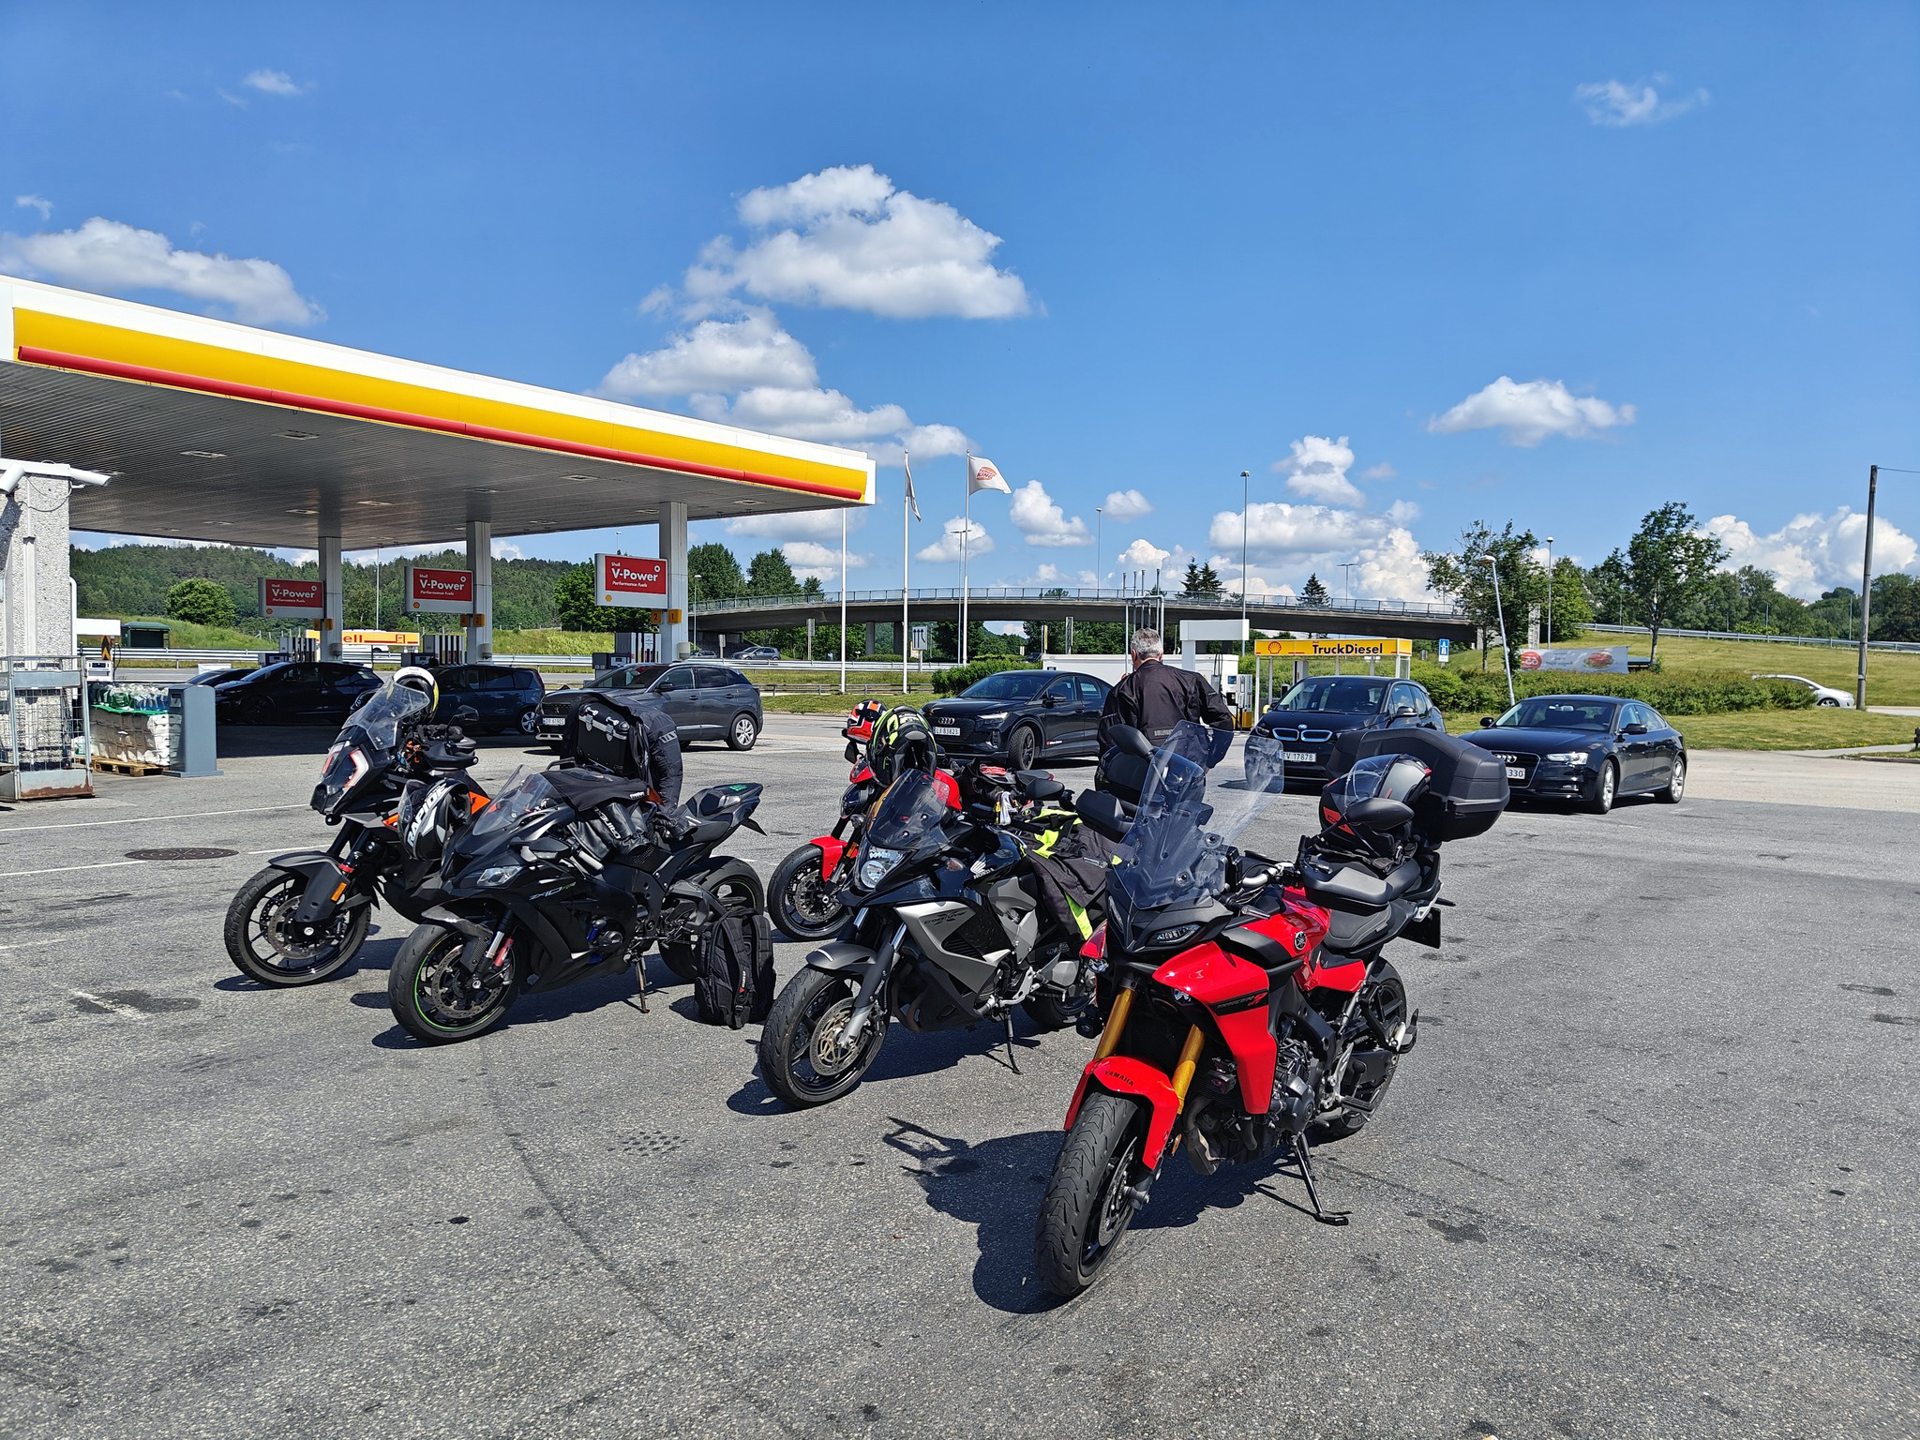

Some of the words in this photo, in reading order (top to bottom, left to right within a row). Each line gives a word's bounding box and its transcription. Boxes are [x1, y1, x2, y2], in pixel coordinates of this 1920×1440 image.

[611, 568, 658, 582] V-Power
[420, 579, 464, 591] V-Power
[272, 588, 316, 599] V-Power
[342, 634, 362, 642] ell
[1312, 643, 1383, 654] TruckDiesel
[1293, 753, 1314, 761] 17878
[1508, 769, 1524, 778] 330
[407, 783, 450, 848] RAPIDE
[973, 868, 994, 879] HONDA
[1104, 1070, 1134, 1087] YAMAHA
